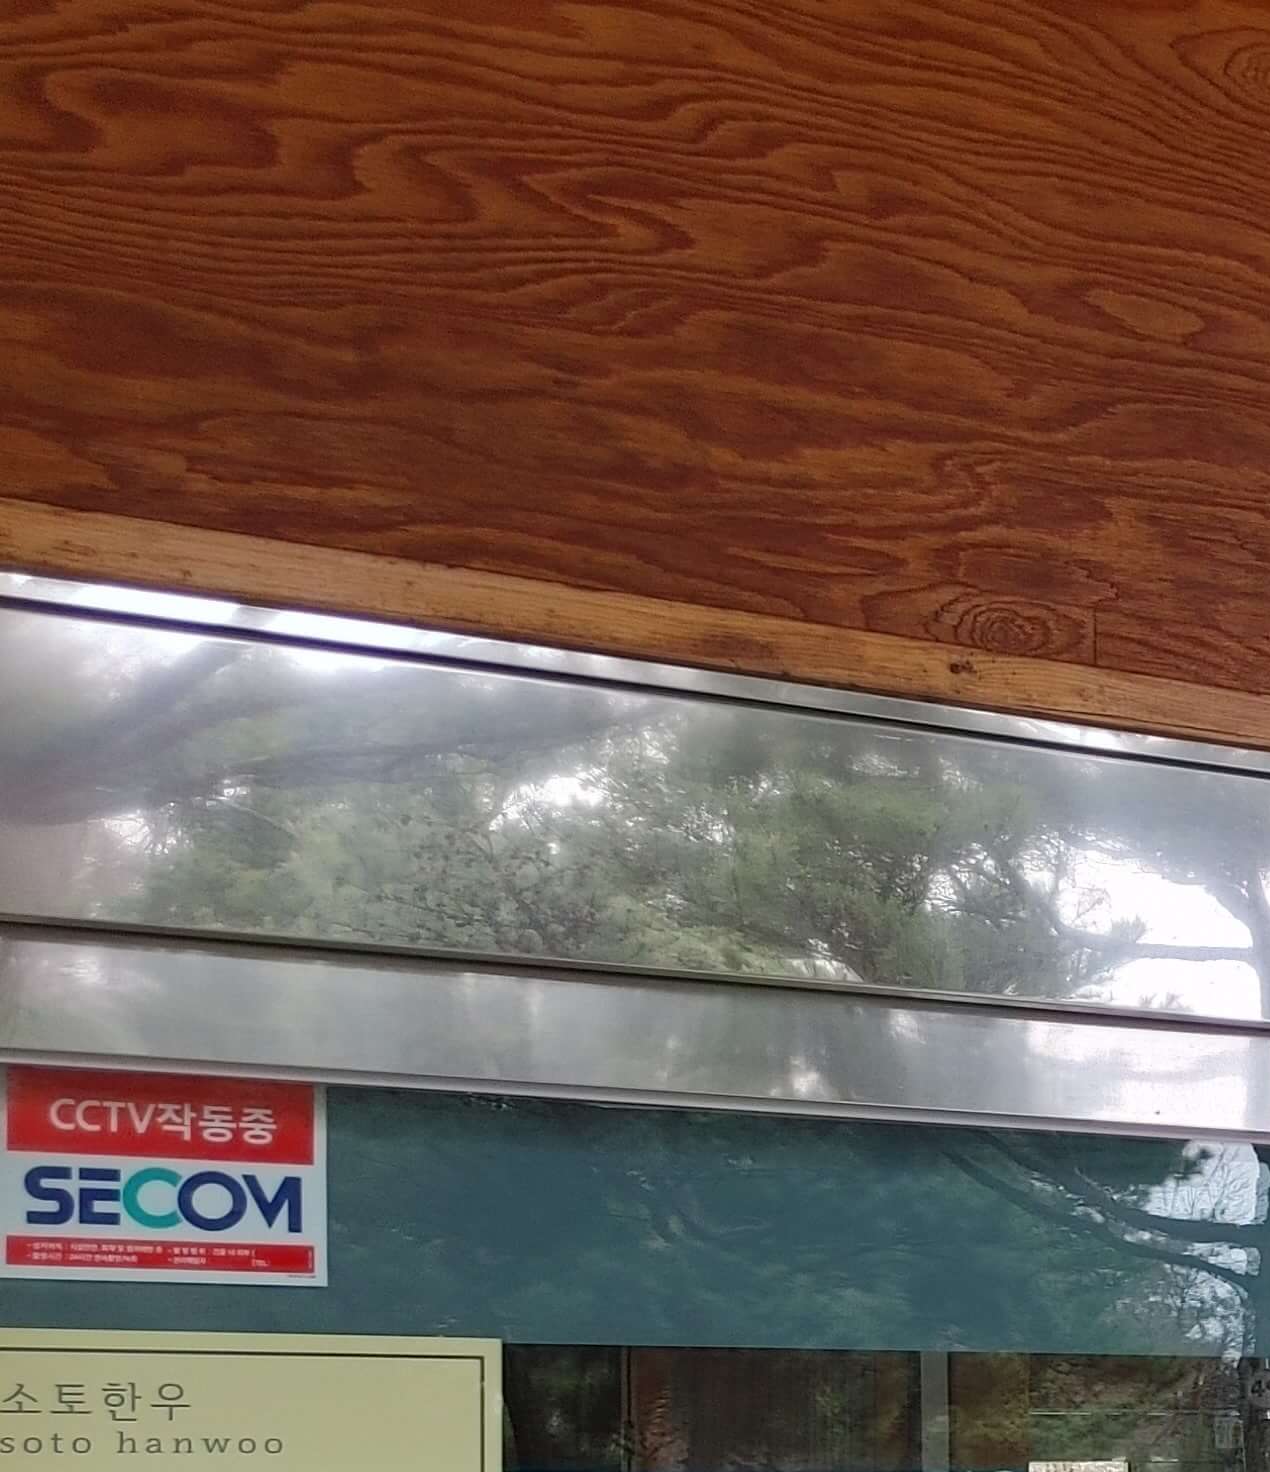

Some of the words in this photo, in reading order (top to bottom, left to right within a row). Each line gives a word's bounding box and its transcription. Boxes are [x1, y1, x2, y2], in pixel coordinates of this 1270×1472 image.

[48, 1098, 278, 1145] CCTV작동중
[24, 1166, 303, 1233] SECOM
[0, 1382, 191, 1422] 소토한우
[0, 1434, 93, 1455] soto
[116, 1431, 284, 1455] hanwoo
